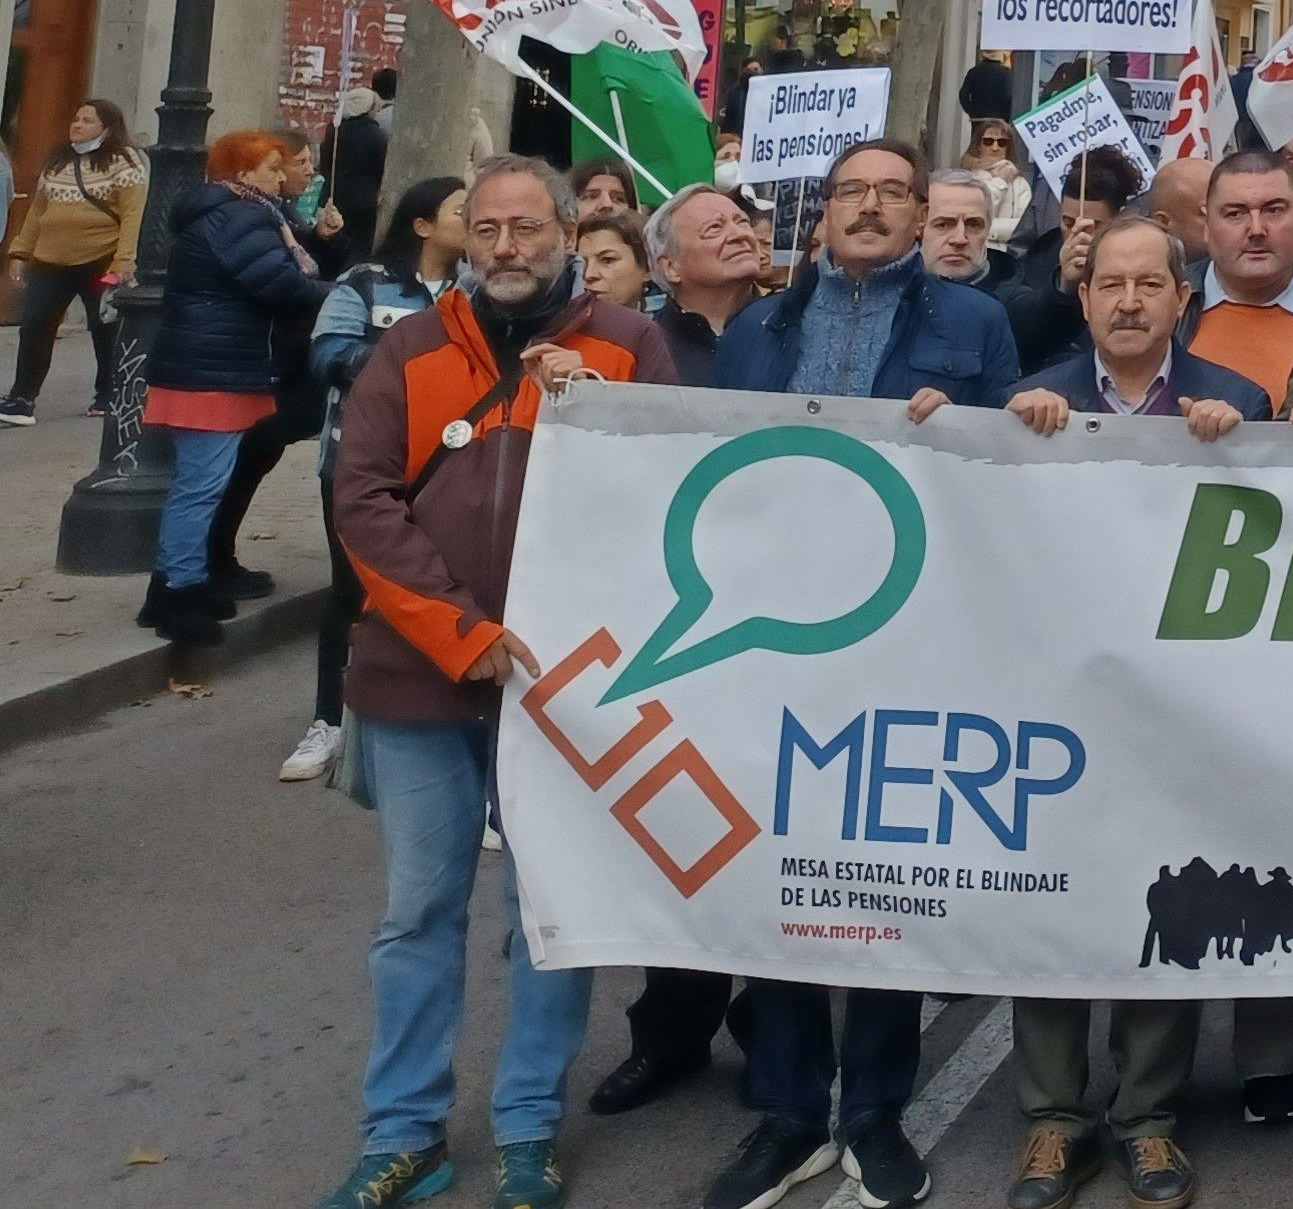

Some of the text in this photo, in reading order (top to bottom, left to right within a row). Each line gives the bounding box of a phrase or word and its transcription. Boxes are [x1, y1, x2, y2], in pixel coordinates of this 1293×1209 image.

[769, 83, 857, 123] ¡Blindar ya
[1025, 91, 1103, 139] Pagadme,
[751, 133, 774, 163] las
[1043, 140, 1068, 163] sin
[1068, 112, 1118, 148] robar,
[773, 705, 1086, 851] MERP
[781, 857, 1068, 892] MESA ESTATAL POR EL BLINDAJE
[781, 887, 947, 918] DE LAS PENSIONES
[781, 922, 902, 944] www.merp.es
